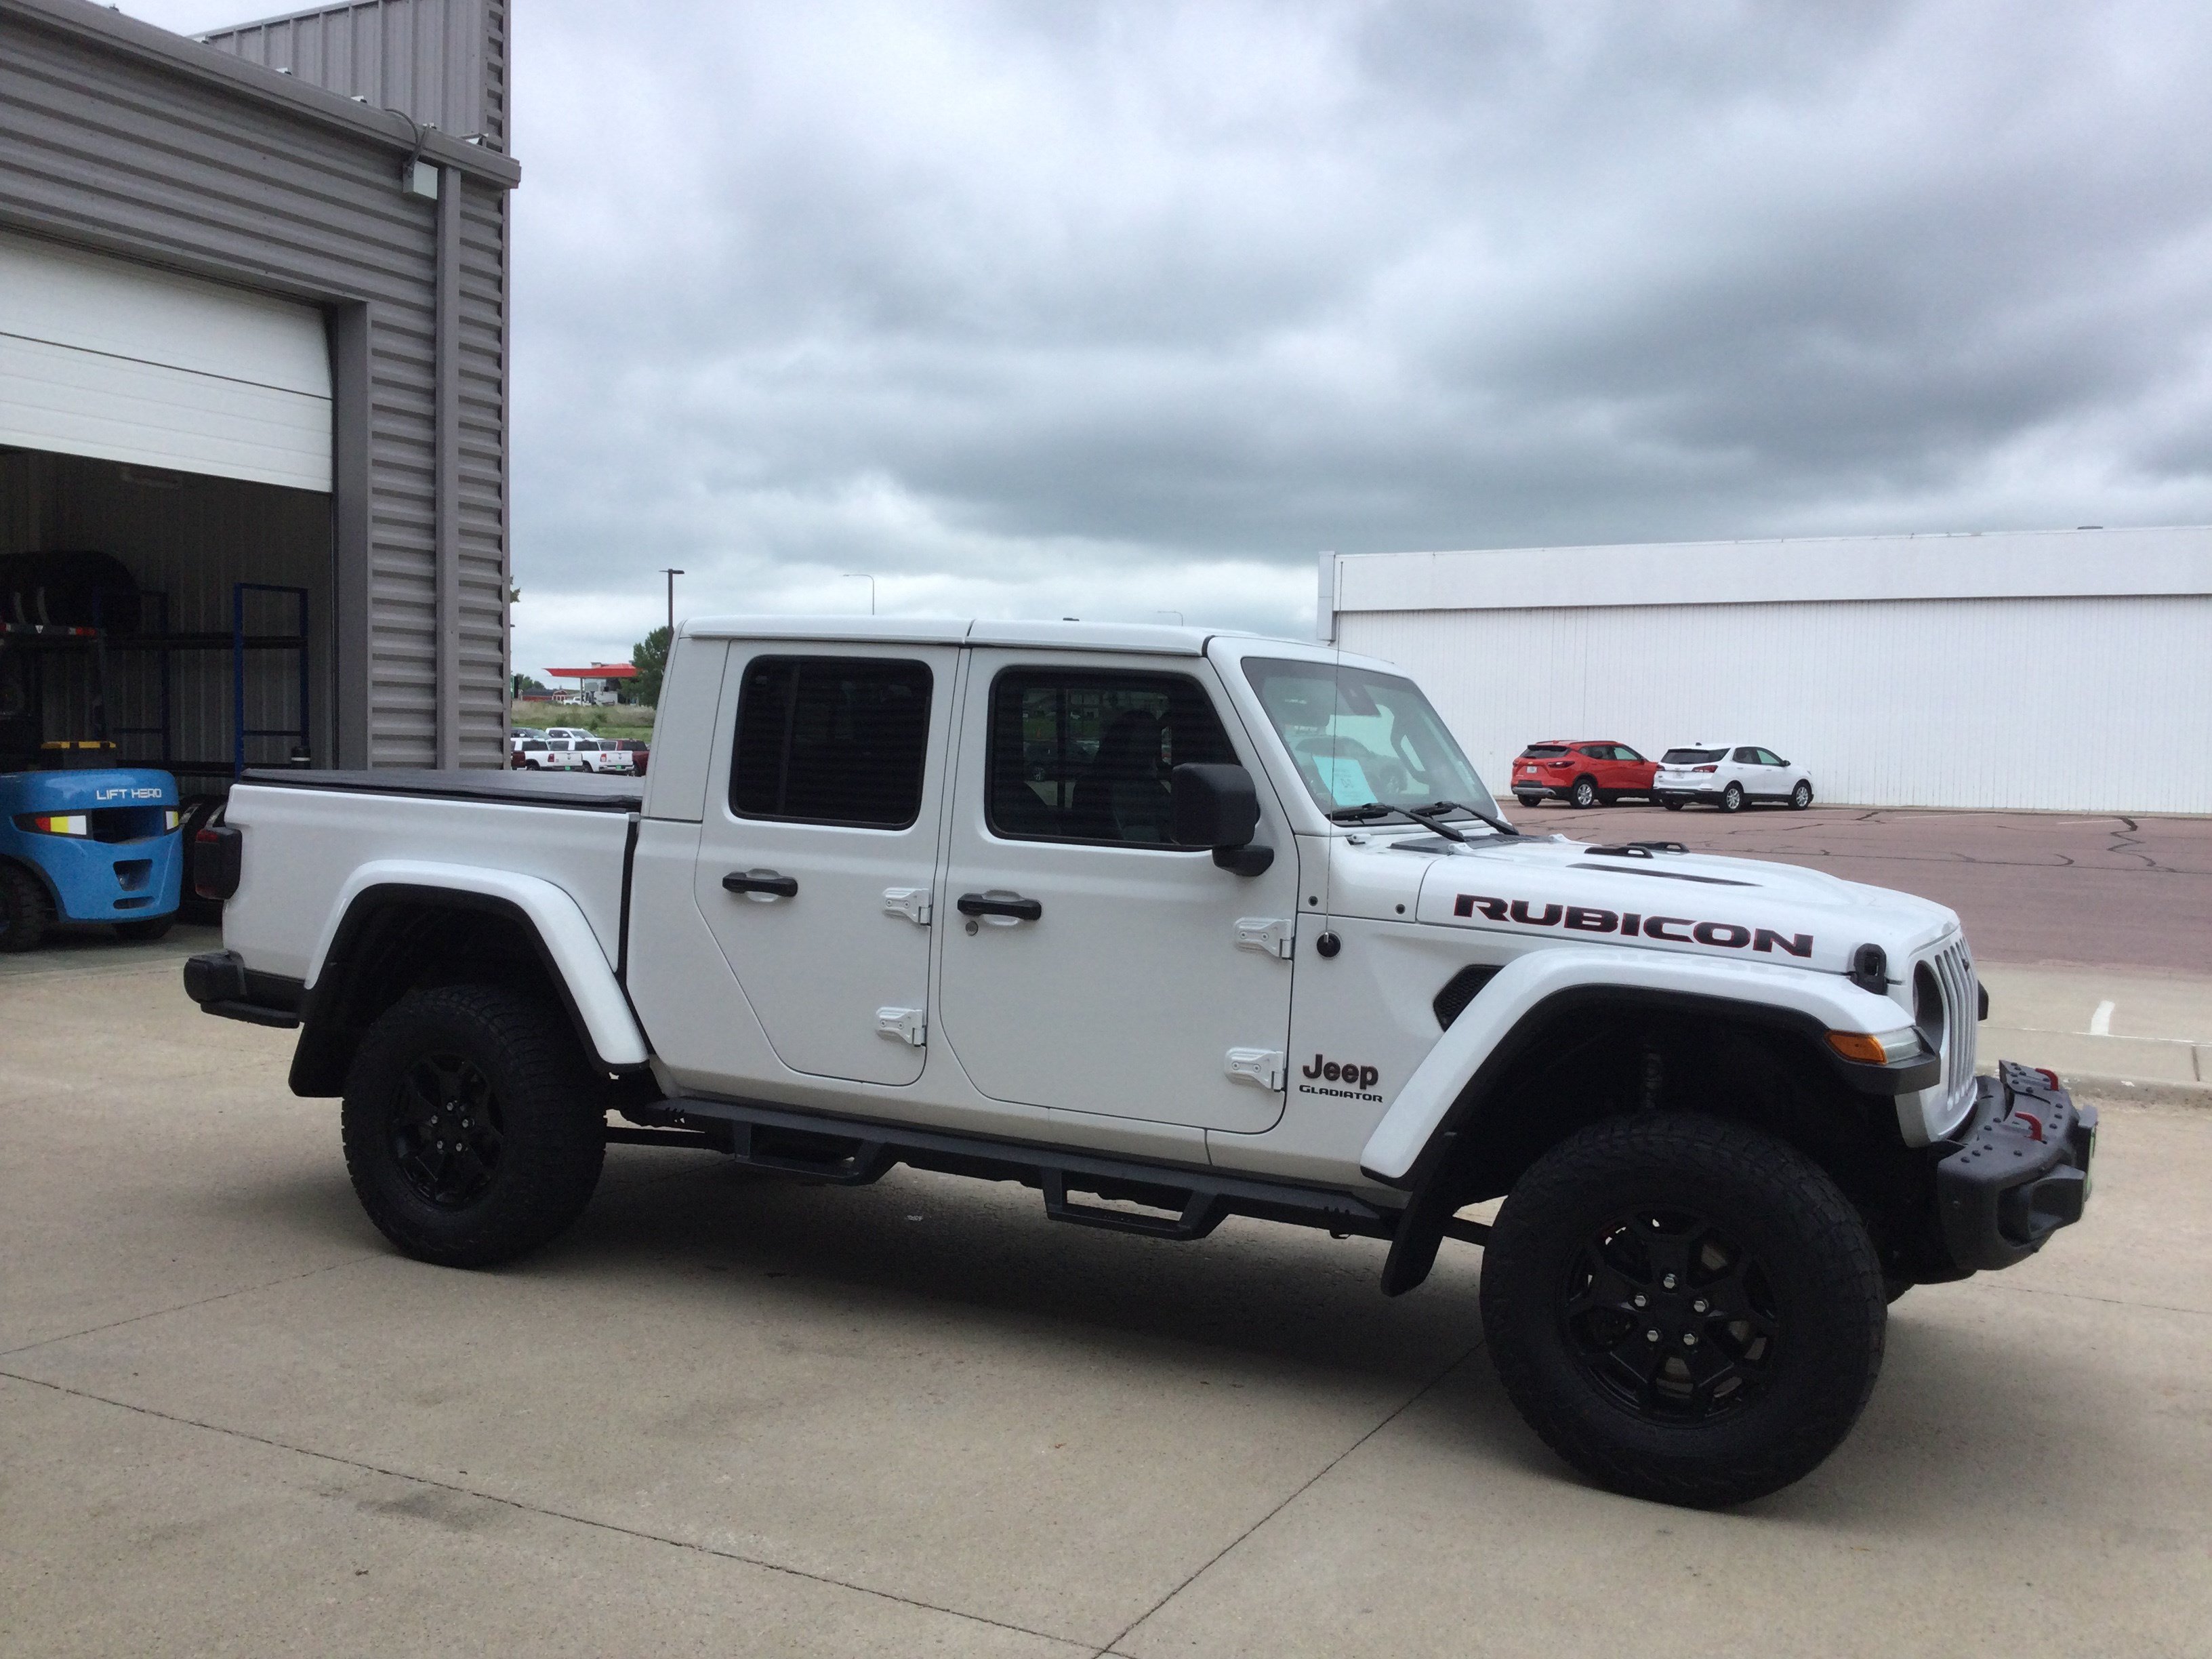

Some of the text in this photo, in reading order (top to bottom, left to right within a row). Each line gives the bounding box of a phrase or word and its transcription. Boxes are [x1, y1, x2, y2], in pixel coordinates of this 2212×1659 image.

[96, 788, 162, 800] LIFT HERO
[1454, 894, 1814, 958] RUBICON
[1303, 1054, 1378, 1090] Jeep
[1299, 1084, 1383, 1103] GLADIATOR
